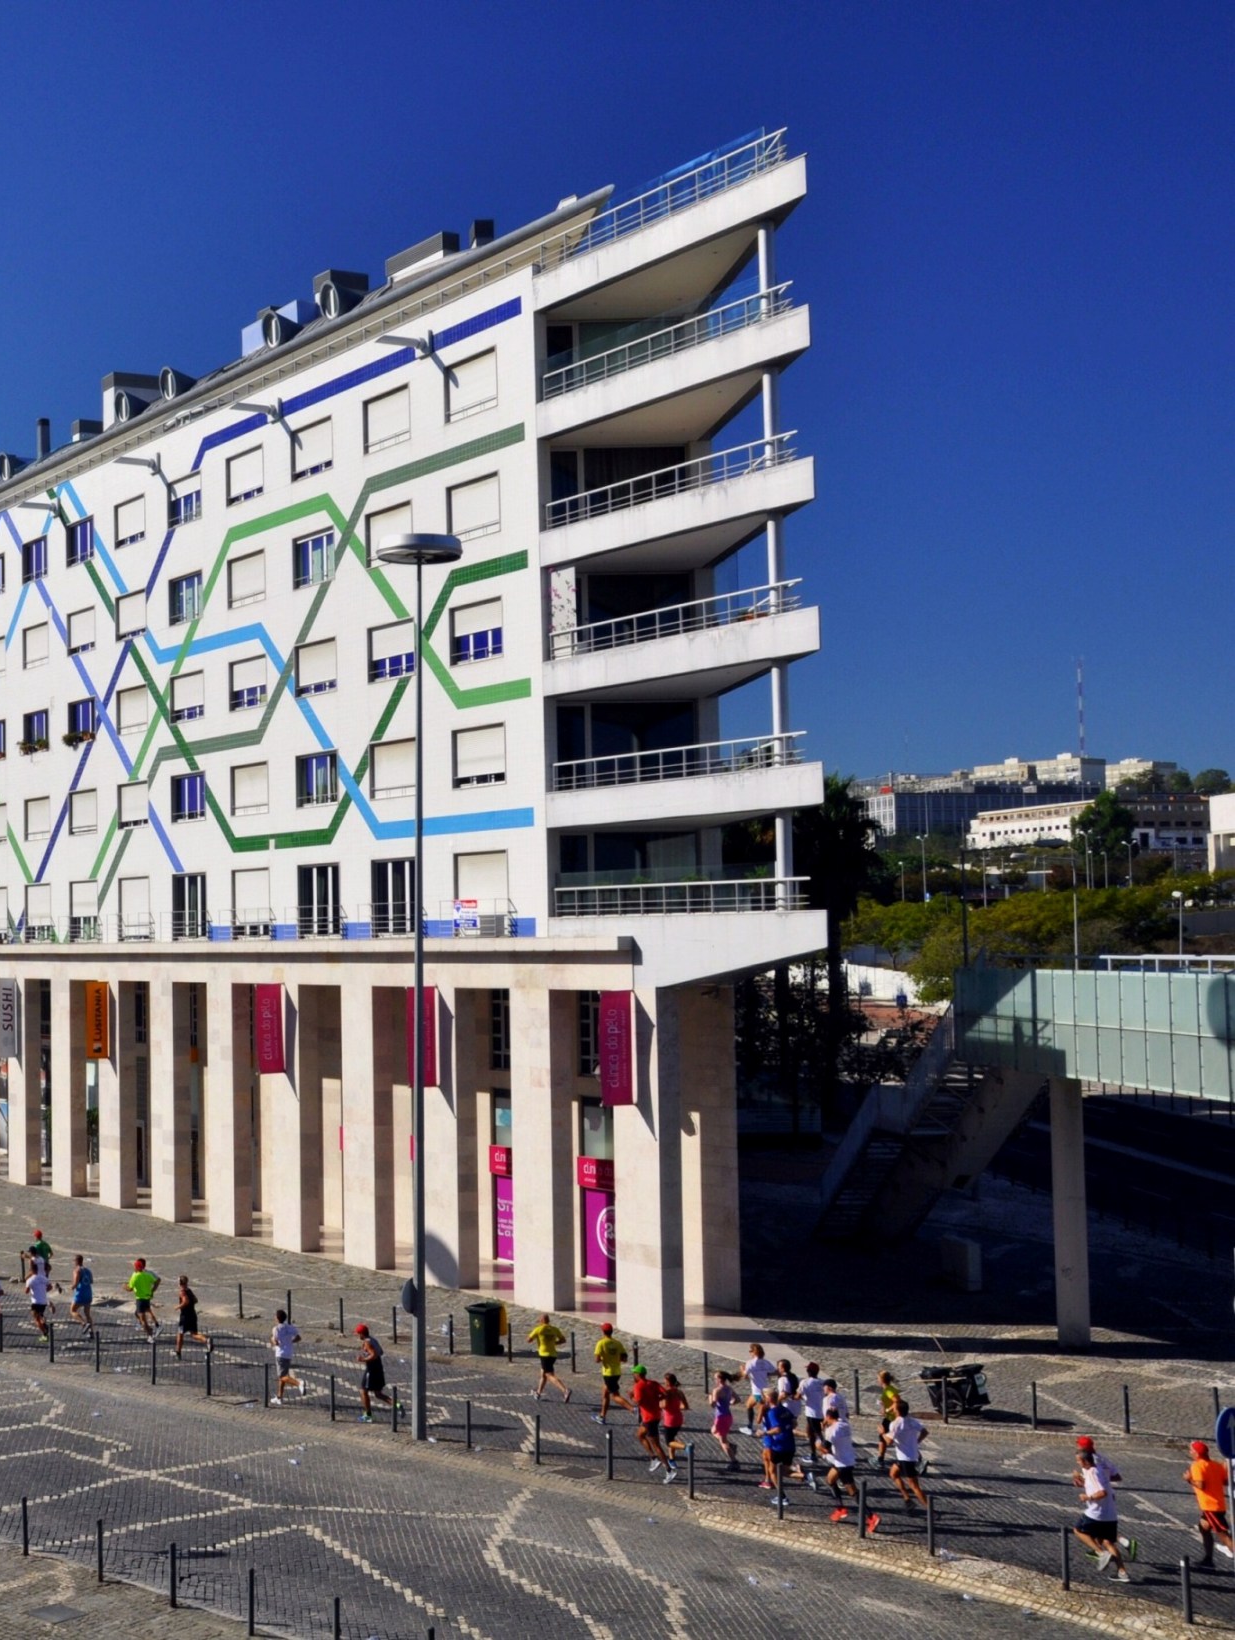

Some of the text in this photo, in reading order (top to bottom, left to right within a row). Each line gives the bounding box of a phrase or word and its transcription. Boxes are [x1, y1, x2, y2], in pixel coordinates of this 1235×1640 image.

[2, 987, 13, 1032] SUSHI
[92, 988, 102, 1042] LUSITANIA
[605, 1036, 618, 1050] do
